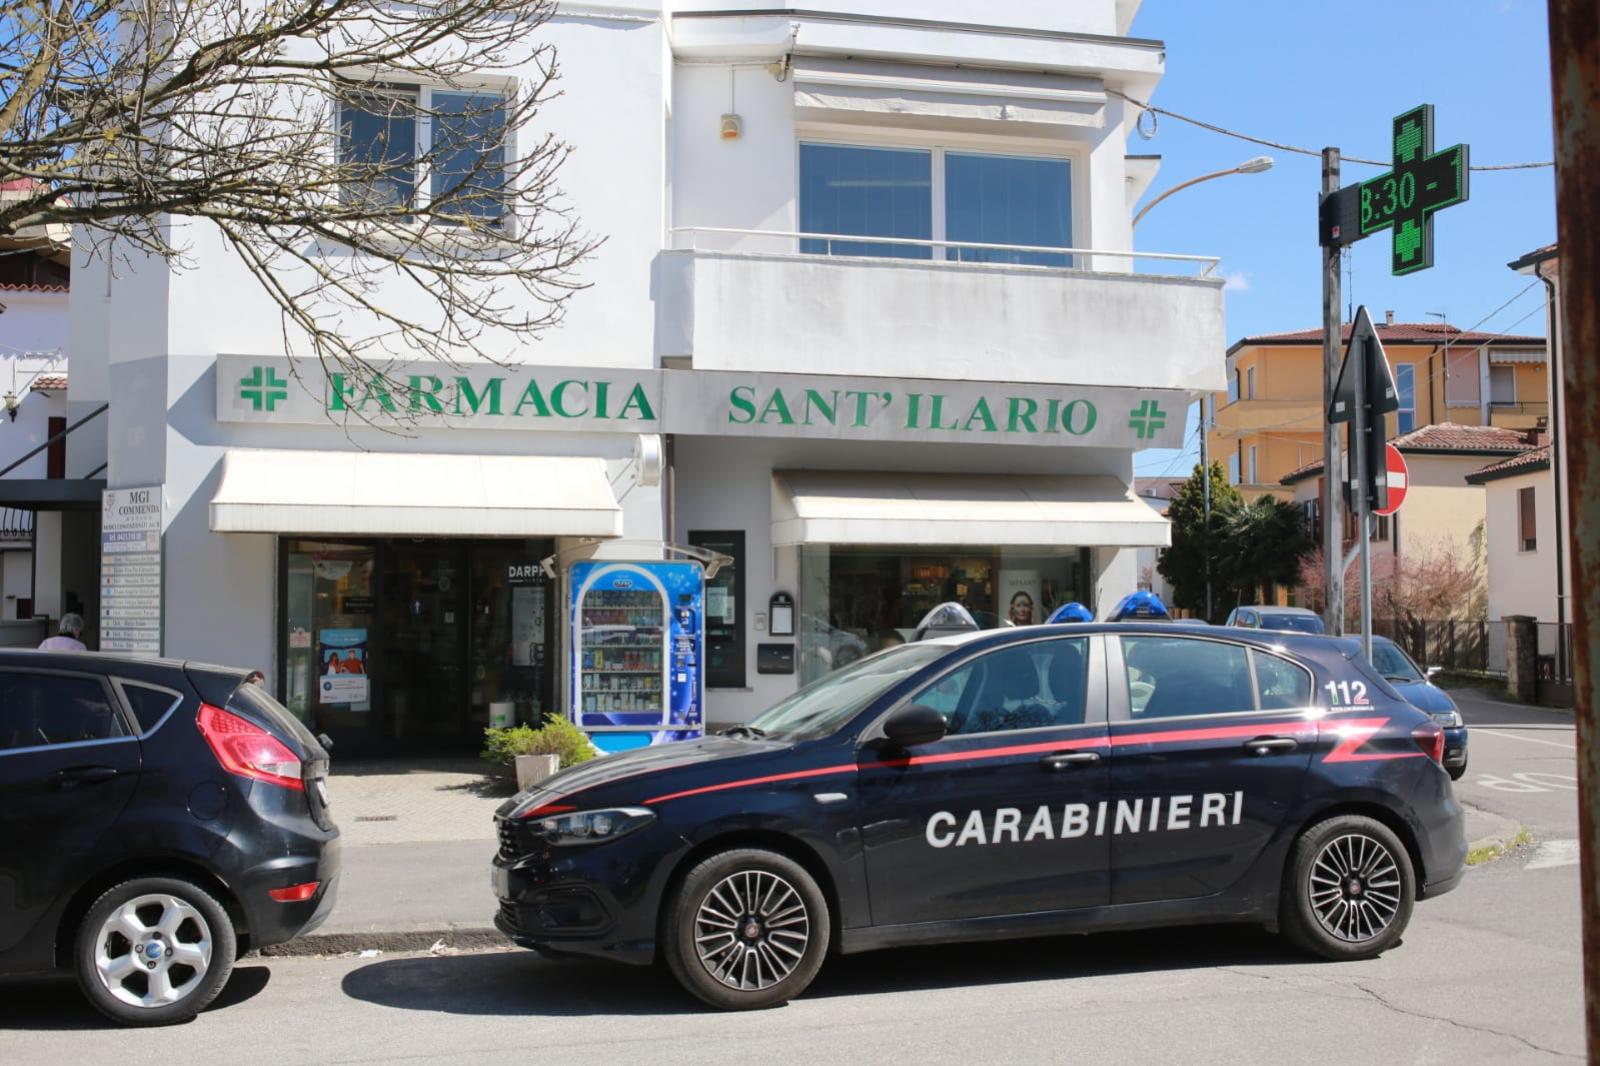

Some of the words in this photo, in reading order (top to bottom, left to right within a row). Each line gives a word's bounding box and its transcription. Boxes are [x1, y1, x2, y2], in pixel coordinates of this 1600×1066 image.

[327, 371, 657, 421] FARMACIA
[118, 504, 160, 515] COMMENDA
[129, 490, 150, 504] MGI
[1325, 680, 1370, 705] 112
[926, 791, 1244, 849] CARABINIERI
